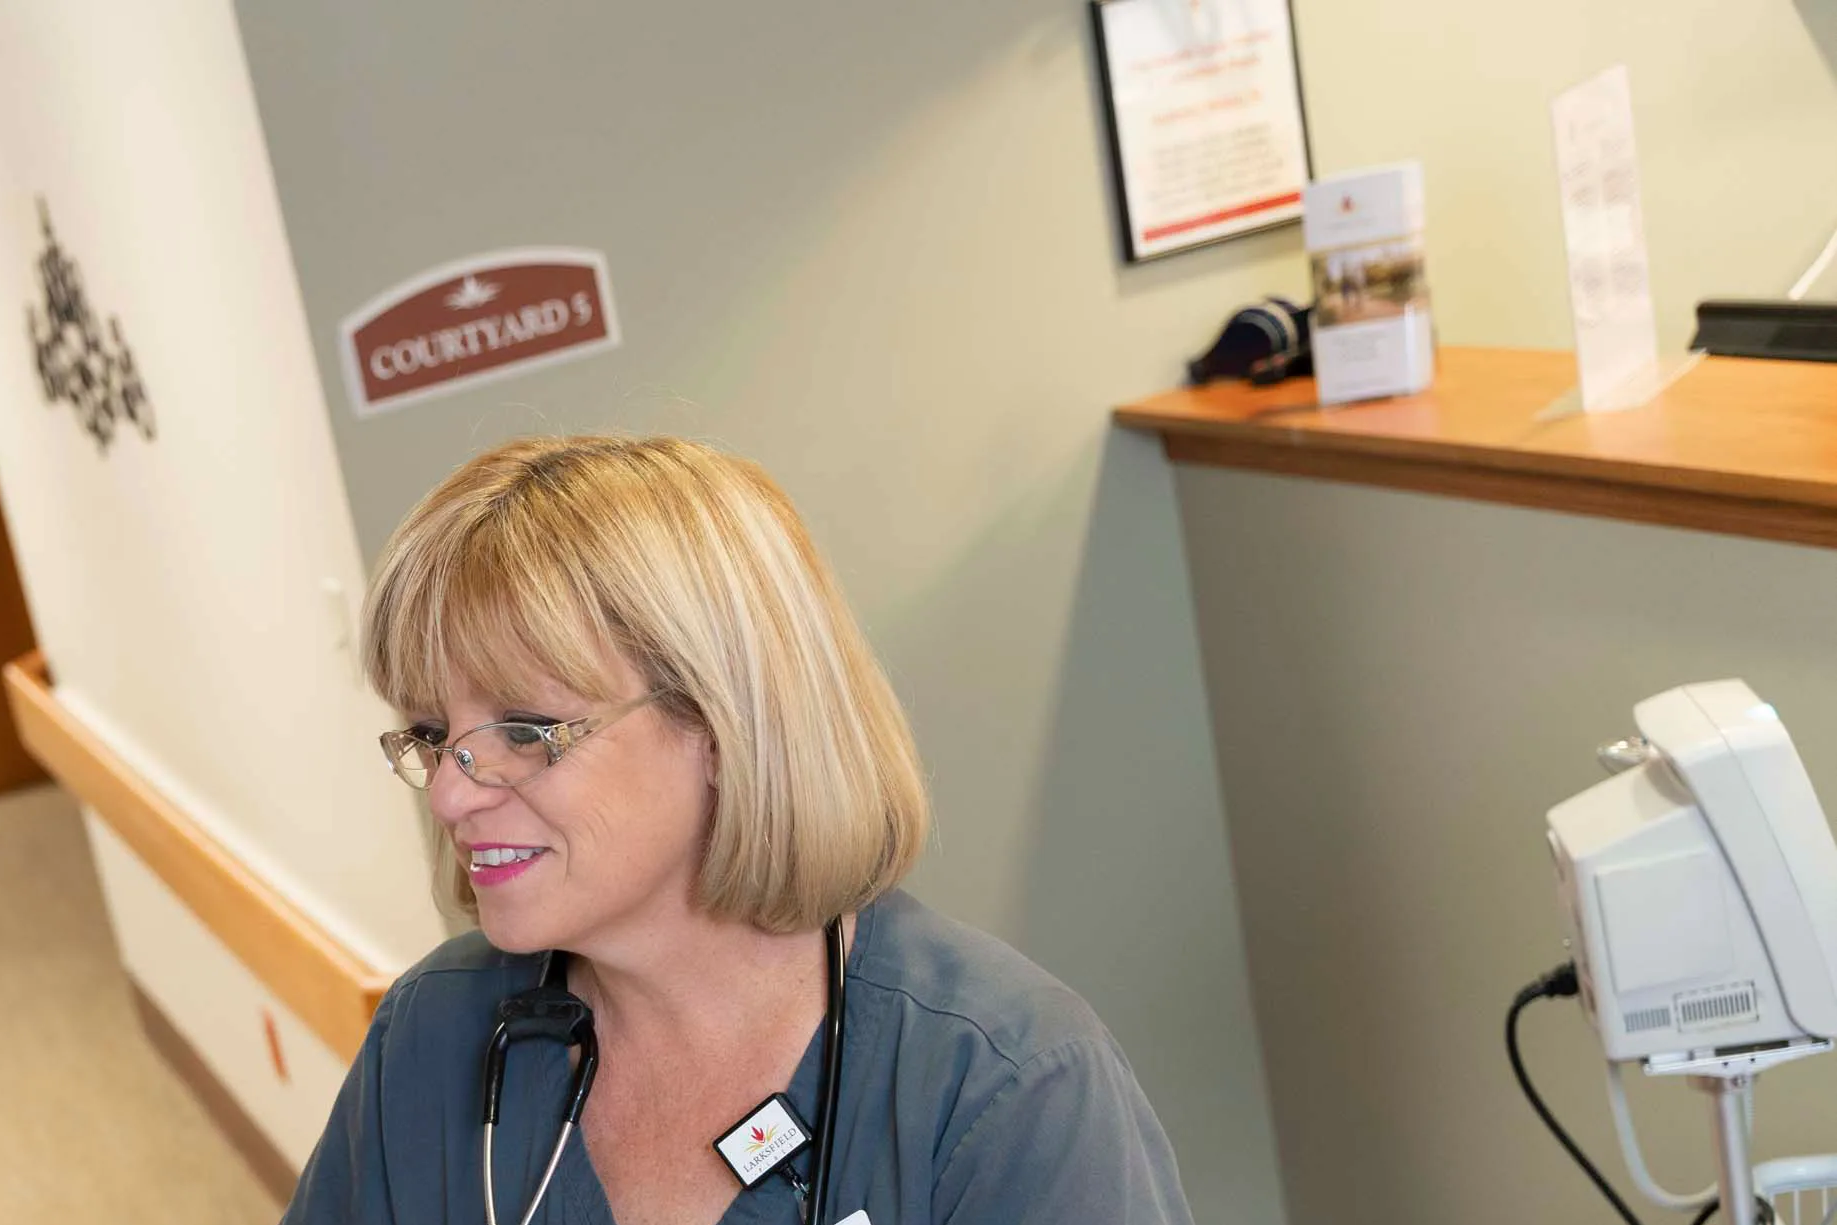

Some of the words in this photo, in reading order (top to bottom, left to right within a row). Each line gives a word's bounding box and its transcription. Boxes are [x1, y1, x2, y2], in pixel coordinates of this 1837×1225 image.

[369, 299, 569, 380] COURTYARD
[572, 291, 592, 326] 5
[743, 1127, 797, 1173] LARKSFIELD
